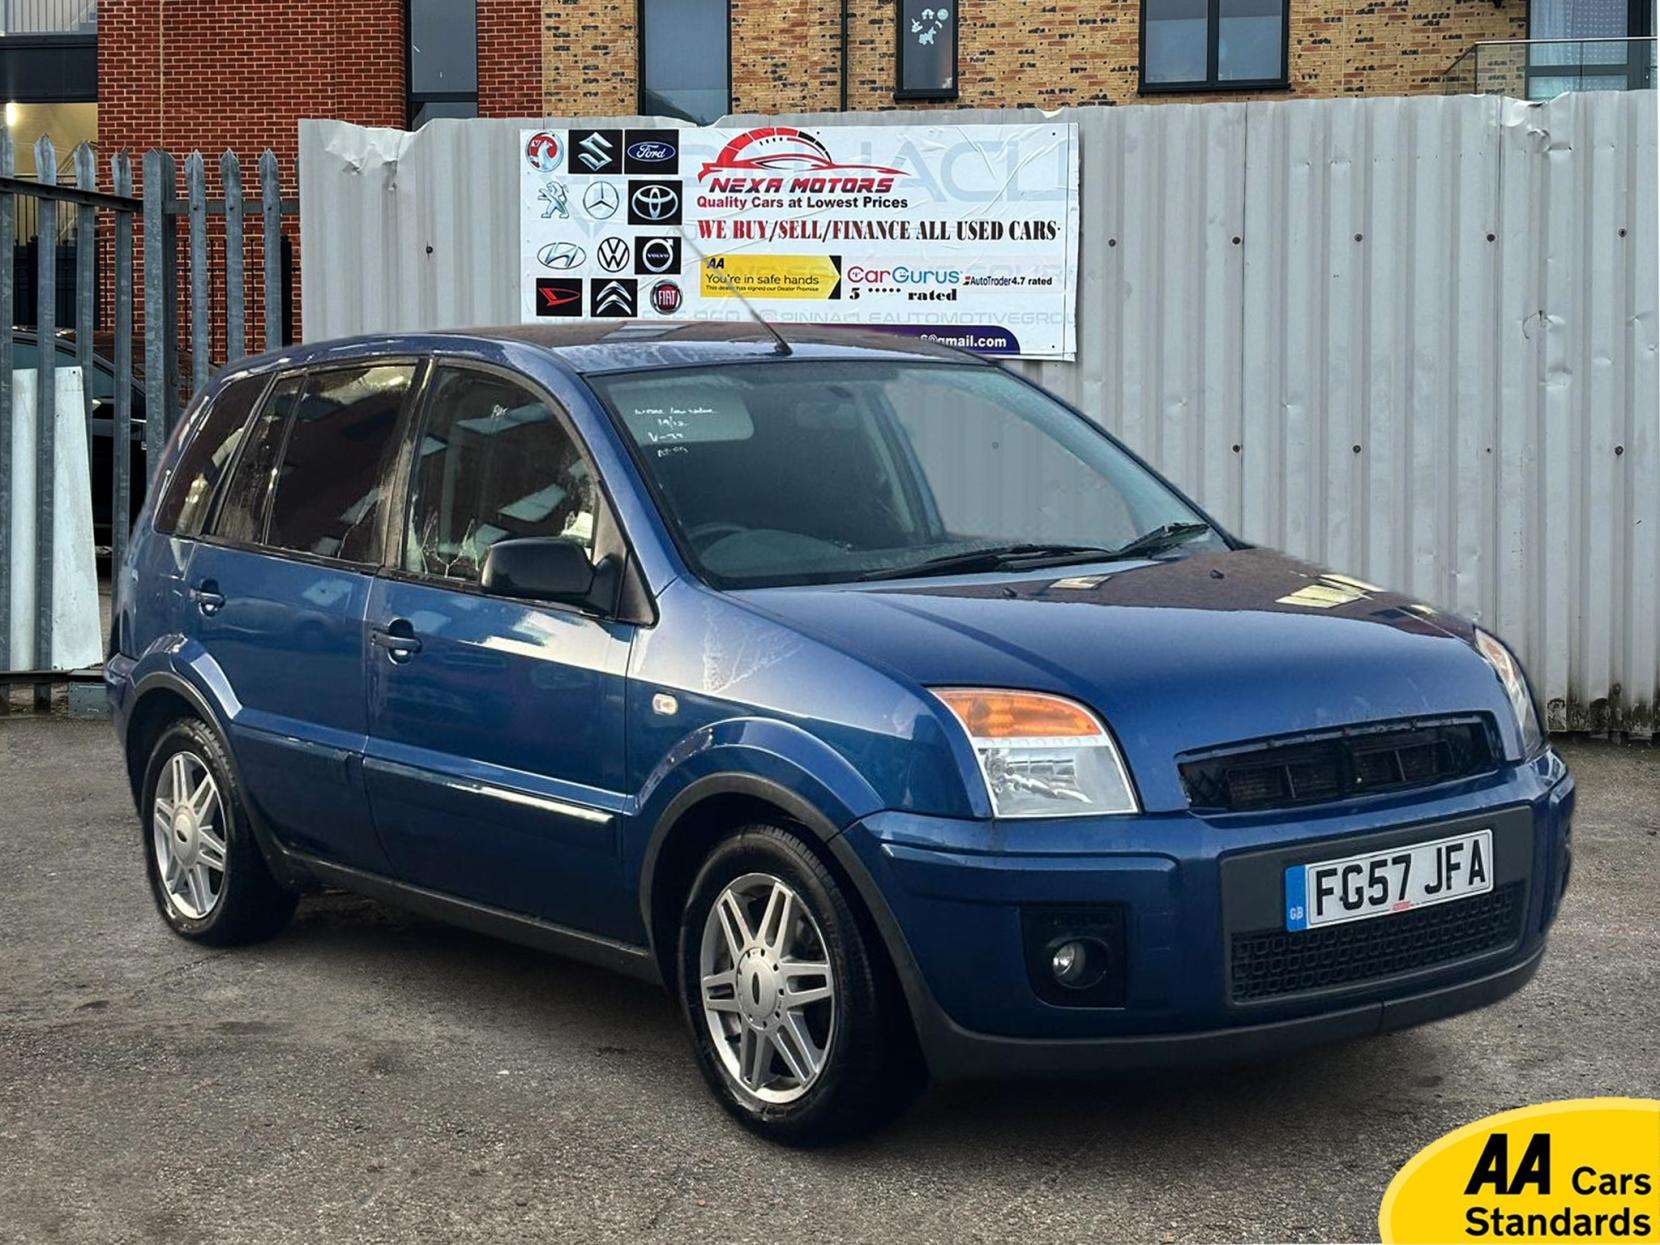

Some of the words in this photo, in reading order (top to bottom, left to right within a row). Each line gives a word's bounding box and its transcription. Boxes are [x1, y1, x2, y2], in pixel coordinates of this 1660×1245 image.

[635, 144, 666, 159] Ford
[709, 178, 783, 193] NEXA
[789, 178, 895, 193] MOTORS
[697, 196, 746, 210] Quality
[752, 196, 784, 208] Cars
[788, 197, 803, 208] at
[807, 196, 859, 208] Lowest
[863, 196, 908, 208] Prices
[698, 219, 727, 240] WE
[916, 220, 951, 240] ALL
[956, 220, 1004, 240] USED
[1008, 220, 1057, 240] CARS
[706, 257, 725, 269] AA
[706, 273, 742, 284] You're
[744, 274, 754, 284] in
[757, 273, 781, 285] safe
[784, 274, 820, 285] hands
[847, 266, 960, 284] CarGurus
[1028, 276, 1053, 286] rated
[658, 290, 676, 306] FIAT
[849, 287, 861, 300] 5
[907, 288, 958, 301] rated
[1289, 906, 1304, 921] GB
[1316, 853, 1412, 916] FG57
[1424, 839, 1486, 895] JFA
